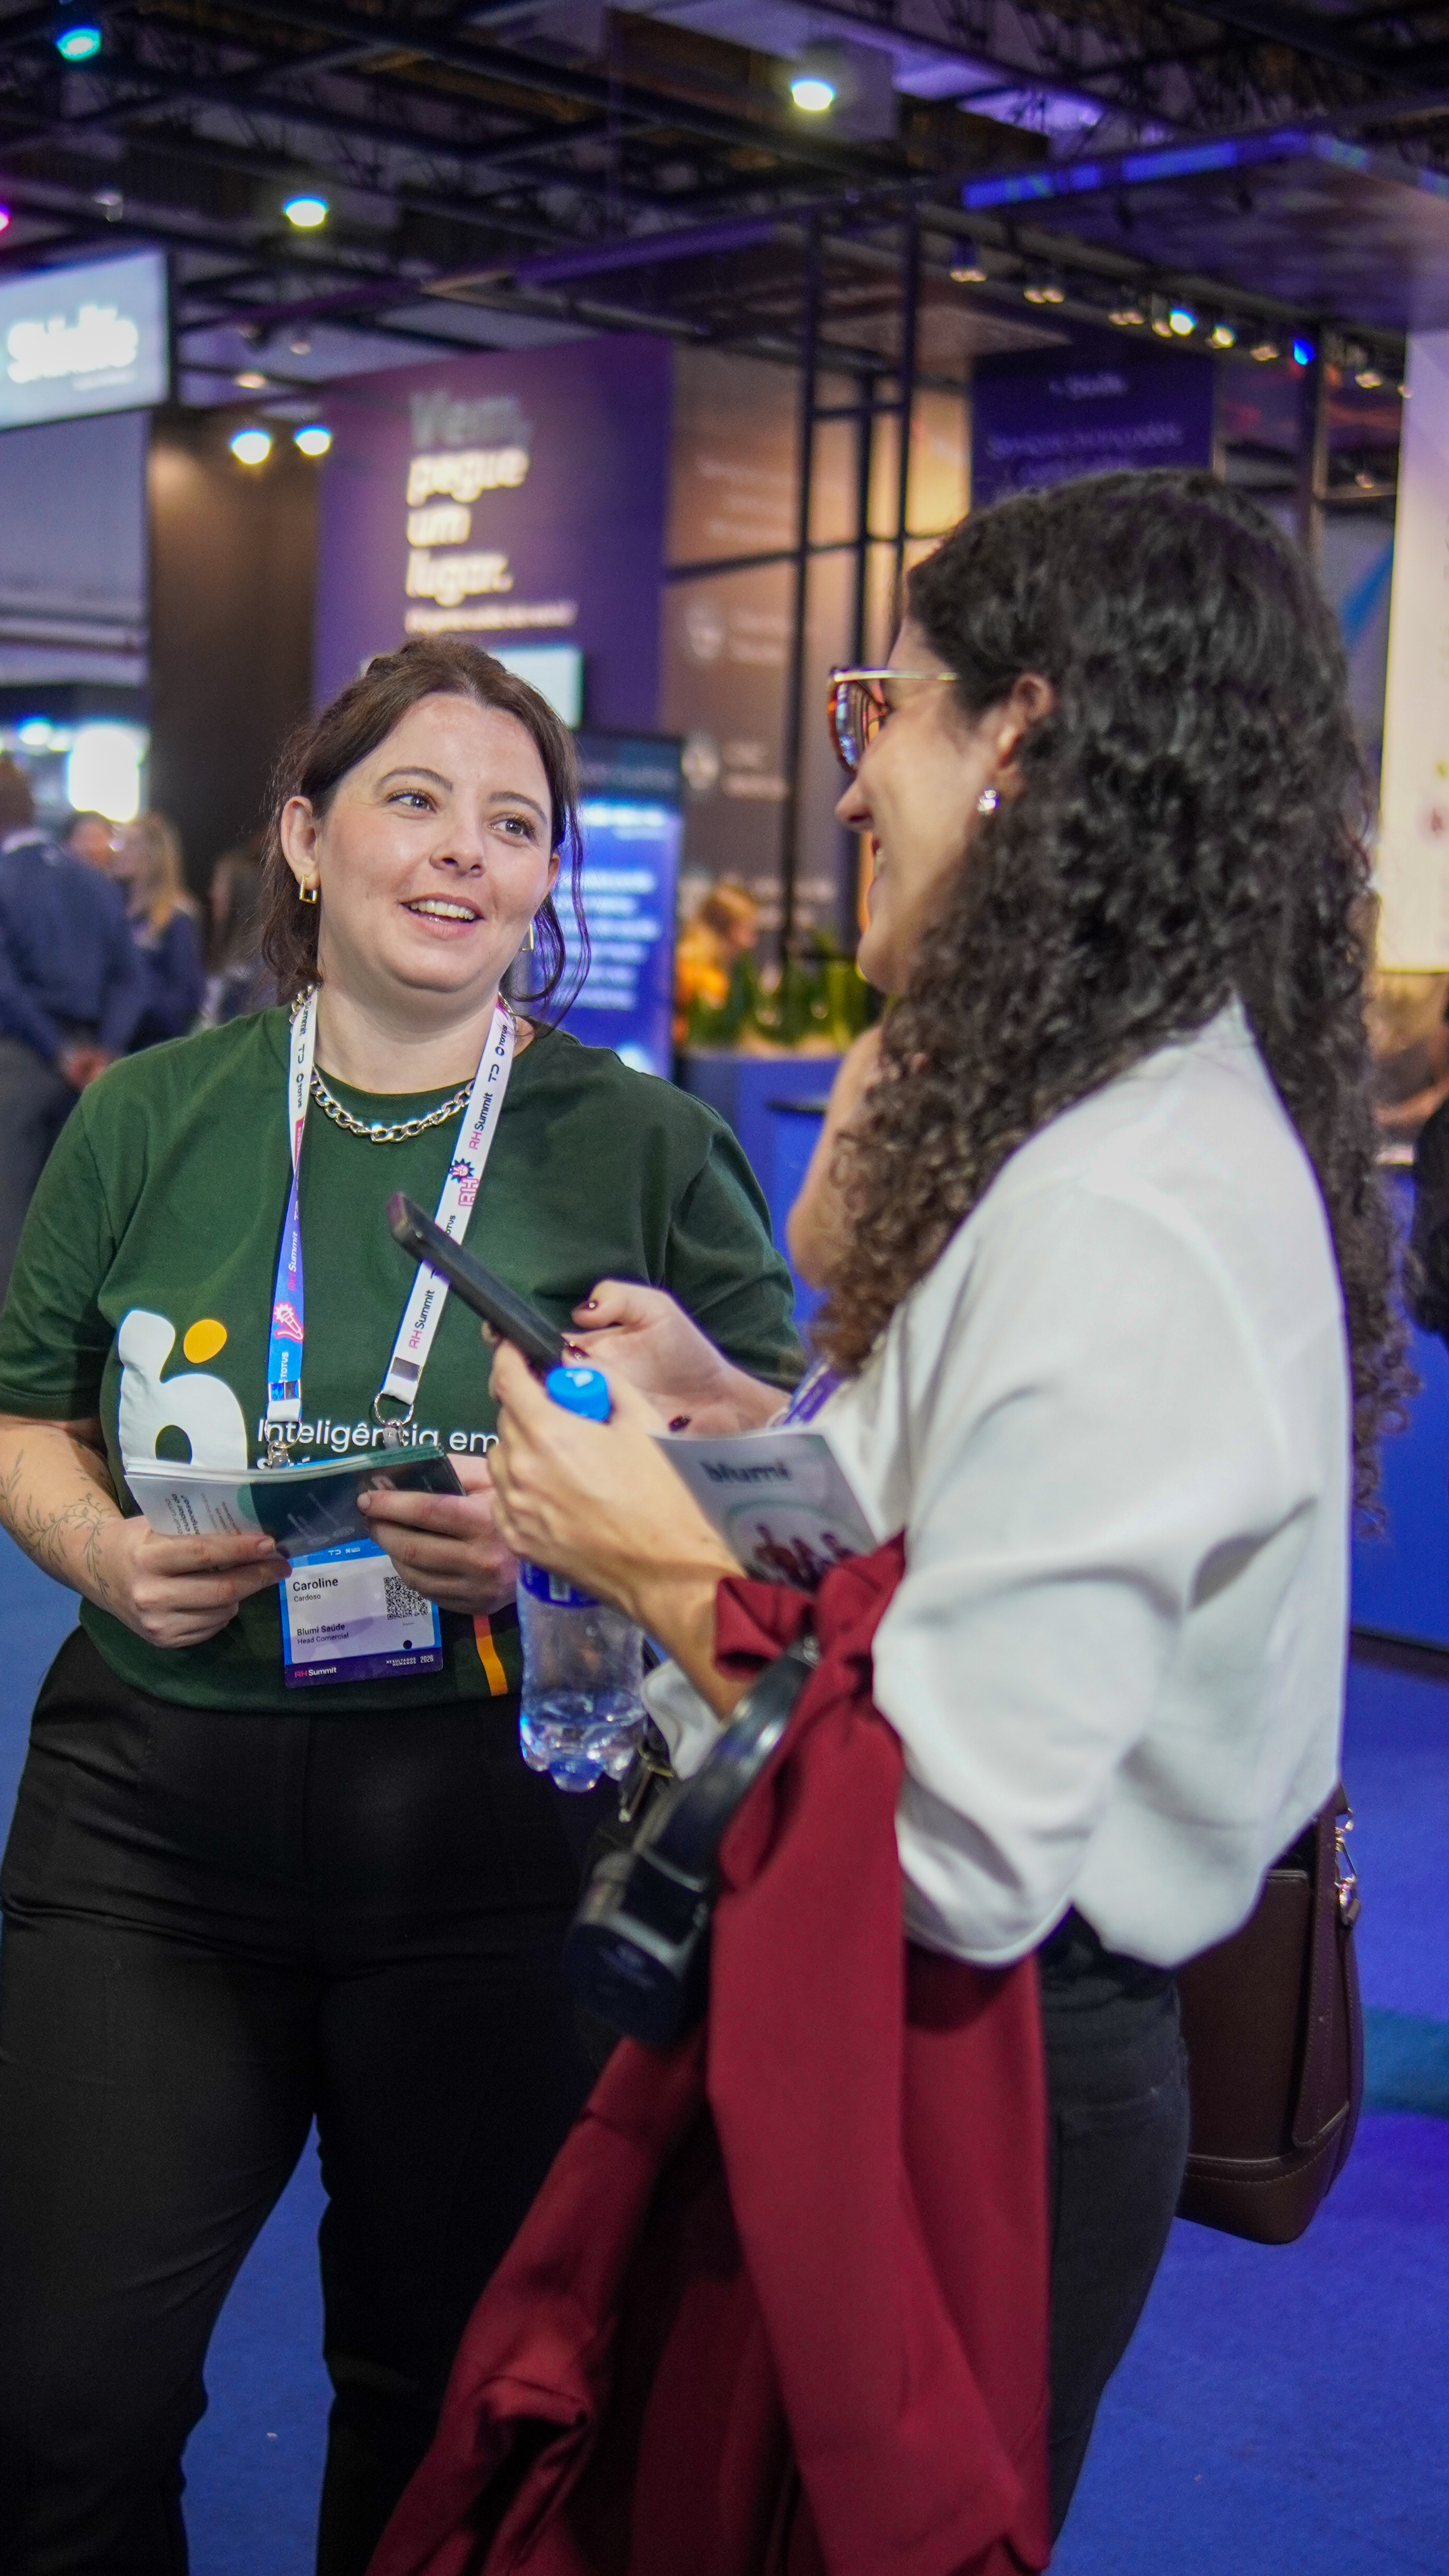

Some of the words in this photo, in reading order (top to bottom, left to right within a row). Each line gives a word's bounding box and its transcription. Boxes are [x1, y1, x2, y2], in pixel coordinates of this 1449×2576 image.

[449, 1431, 500, 1453] em
[701, 1458, 790, 1484] blumi
[293, 1578, 339, 1592] Caroline
[294, 1594, 321, 1603] Cardoso
[297, 1626, 319, 1636] Blumi
[321, 1623, 345, 1633] Saúde
[297, 1637, 315, 1645] Head
[316, 1632, 349, 1642] Comercial
[420, 1654, 434, 1664] 2026
